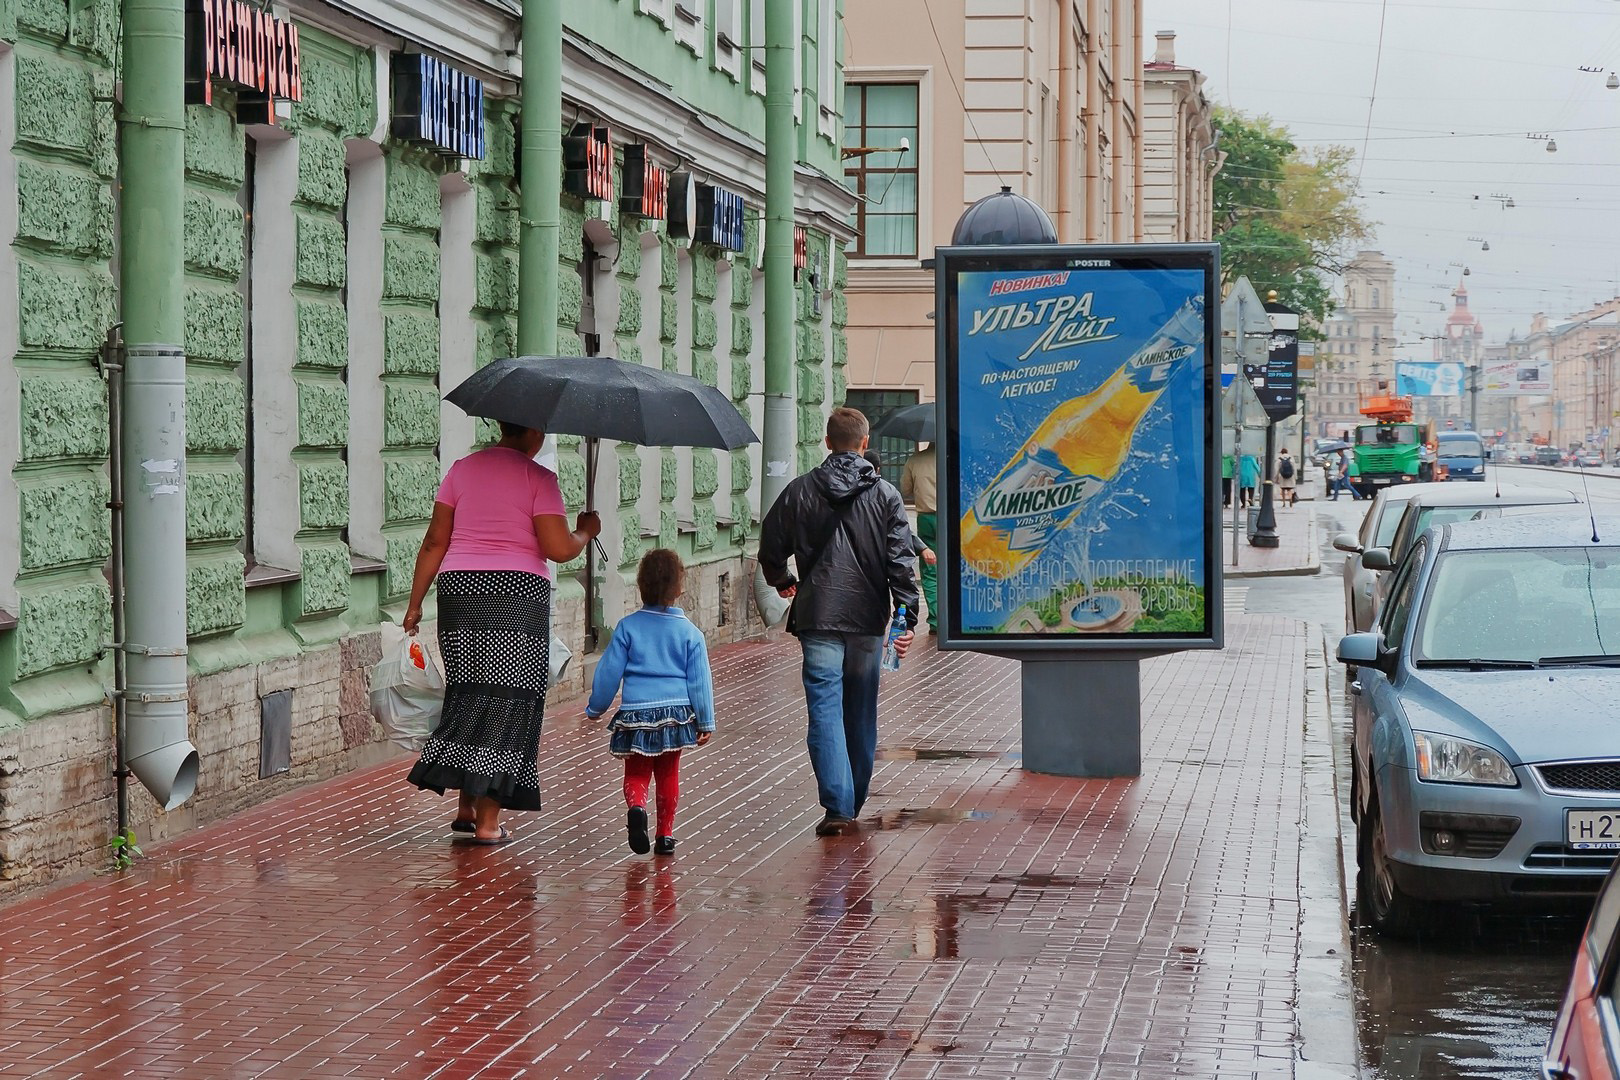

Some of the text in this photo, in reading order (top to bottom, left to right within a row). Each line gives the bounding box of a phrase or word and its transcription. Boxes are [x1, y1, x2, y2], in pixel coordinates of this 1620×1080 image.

[1075, 259, 1111, 267] POSTER
[989, 271, 1070, 296] НОВИНКА!
[969, 292, 1094, 335] УЛЬТРА
[1019, 316, 1120, 361] Лайт
[1136, 347, 1187, 366] КЛИНСКОЕ
[981, 359, 1081, 384] ПО-НАСТОЯЩЕМУ
[1001, 378, 1058, 399] ЛЕГКОЕ!
[983, 480, 1087, 517] КЛИНСКОЕ
[1016, 513, 1052, 527] УЛЬТРА
[967, 558, 1197, 586] ЧРЕЗМЕРНОЕ УПОТРЕБЛЕНИЕ
[968, 586, 1007, 612] ПИВА
[1009, 586, 1058, 612] ВРЕДИТ
